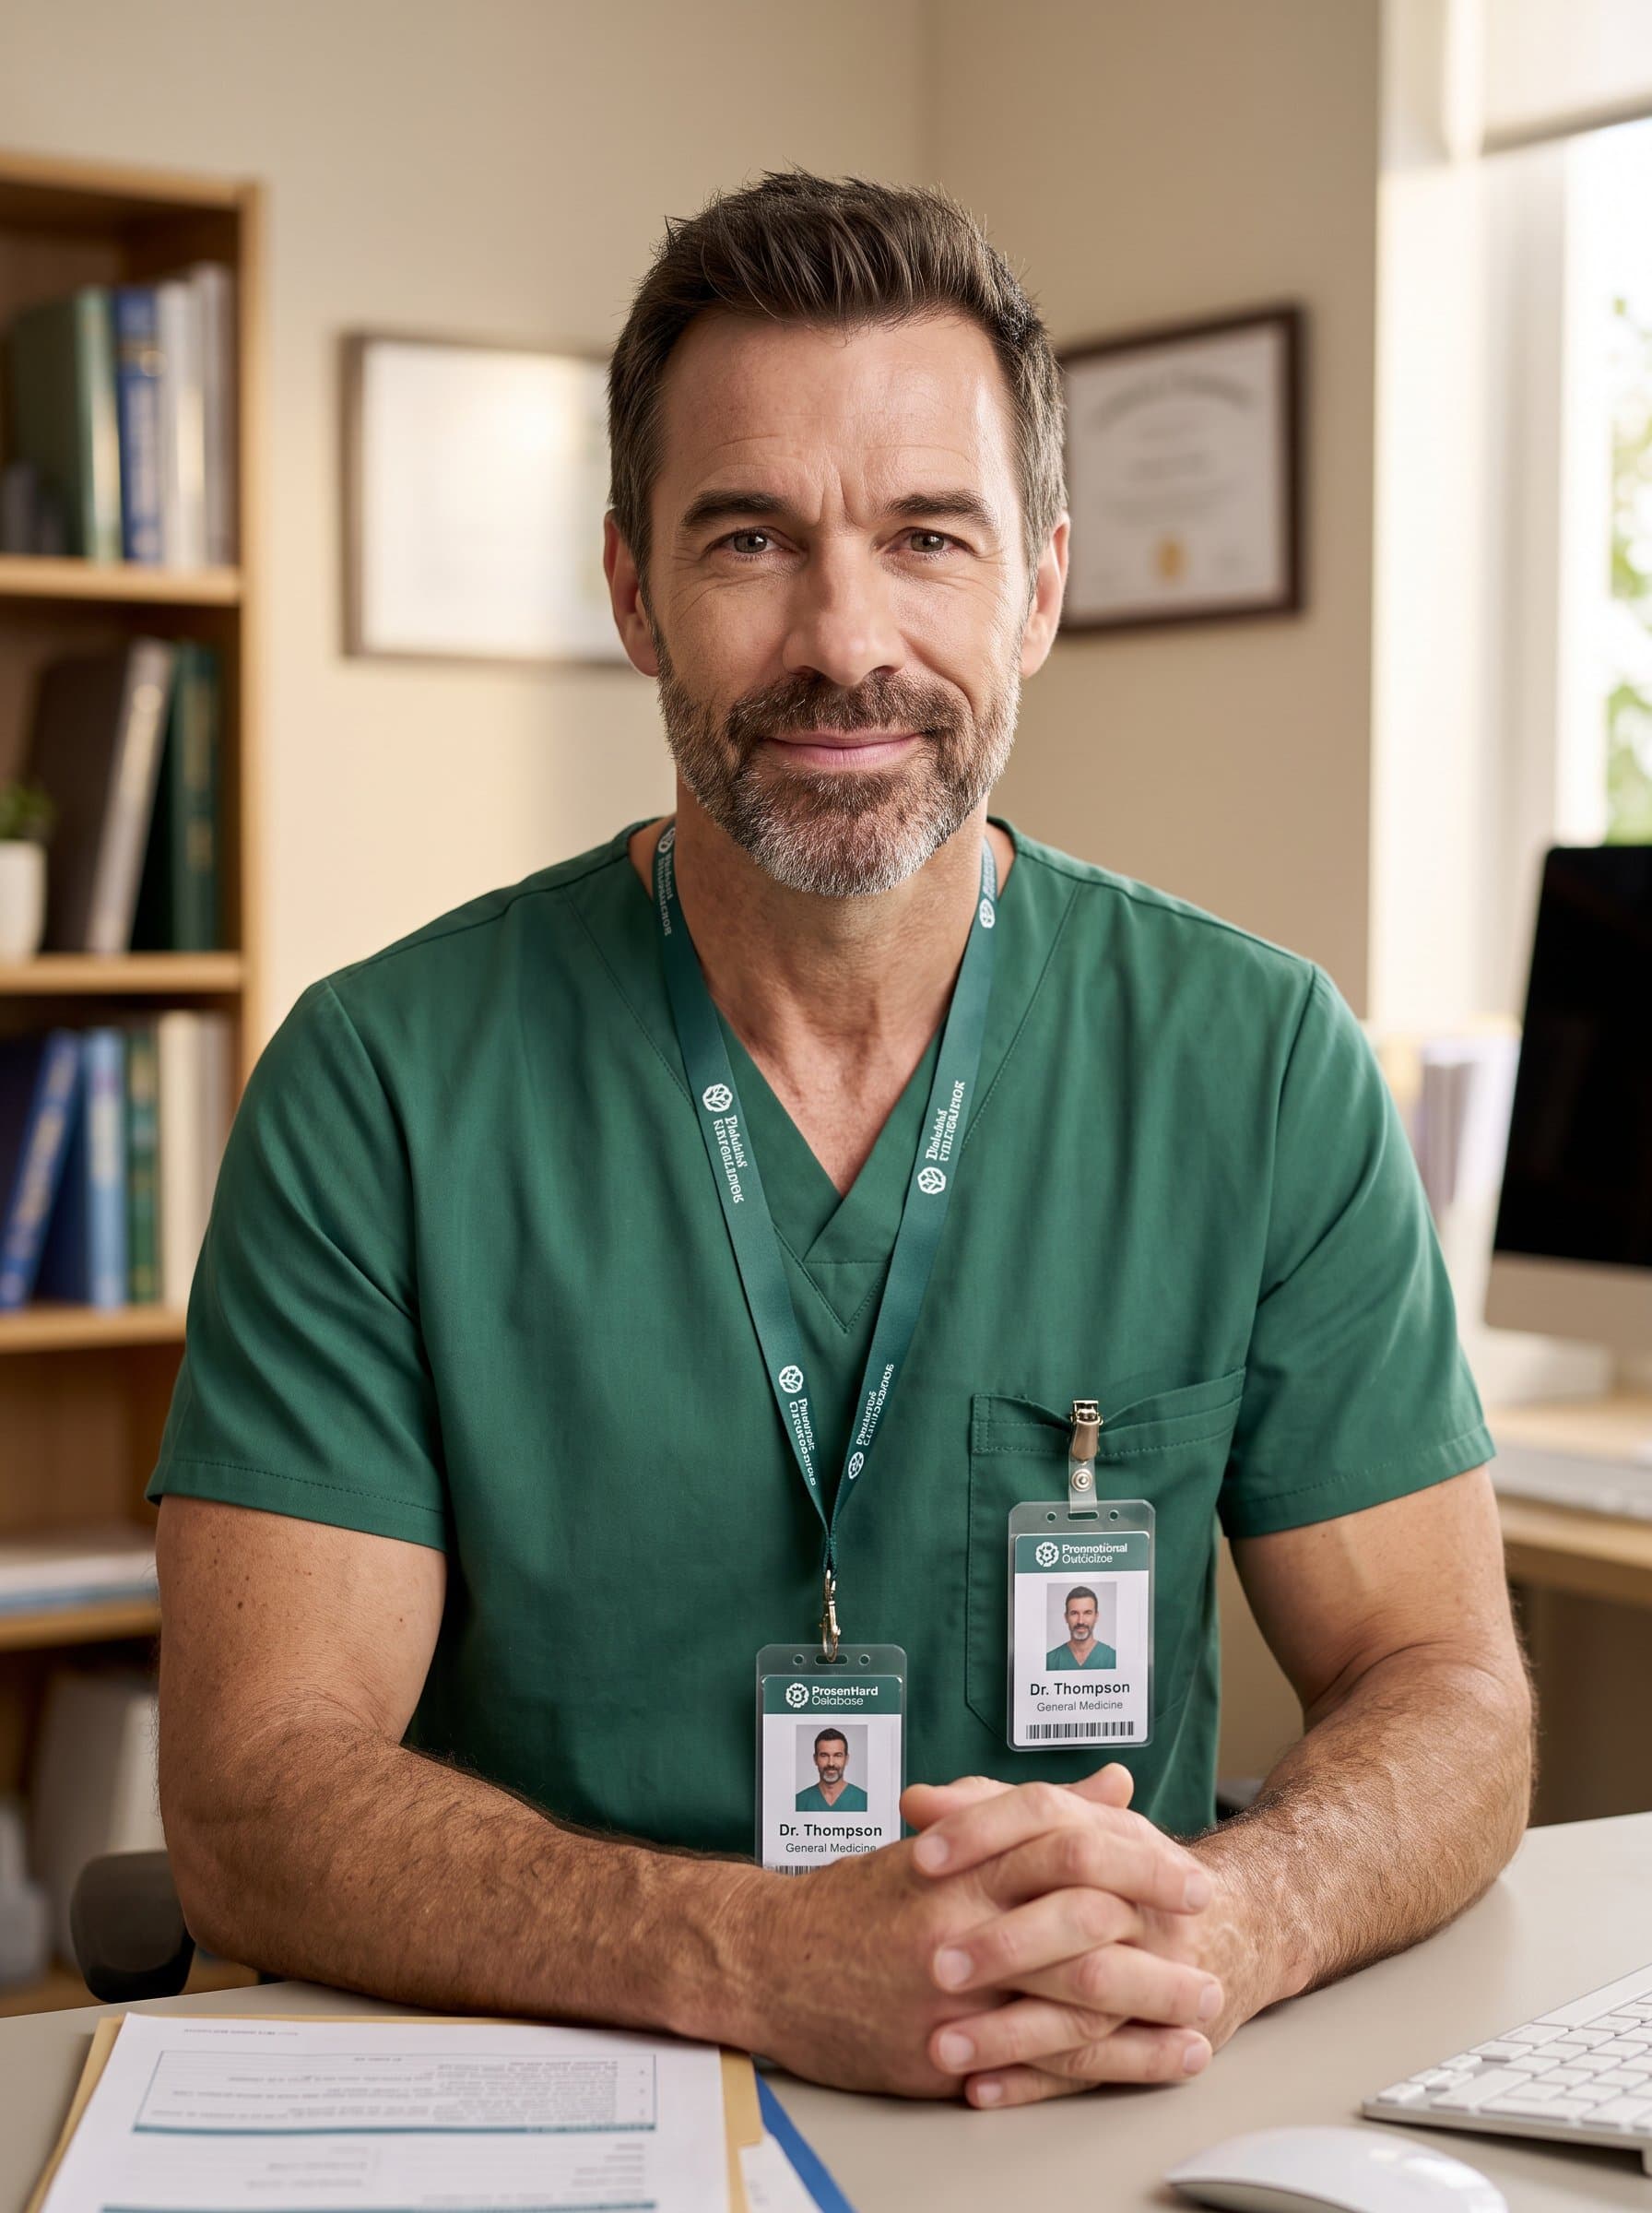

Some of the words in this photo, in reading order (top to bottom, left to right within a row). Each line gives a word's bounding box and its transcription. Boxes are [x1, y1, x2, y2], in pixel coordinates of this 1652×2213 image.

[1030, 1683, 1049, 1696] Dr.
[1054, 1683, 1130, 1697] Thompson
[1036, 1701, 1077, 1712] General
[1079, 1700, 1124, 1710] Medicine
[779, 1823, 799, 1837] Dr.
[803, 1823, 882, 1840] Thompson
[785, 1842, 827, 1852] General
